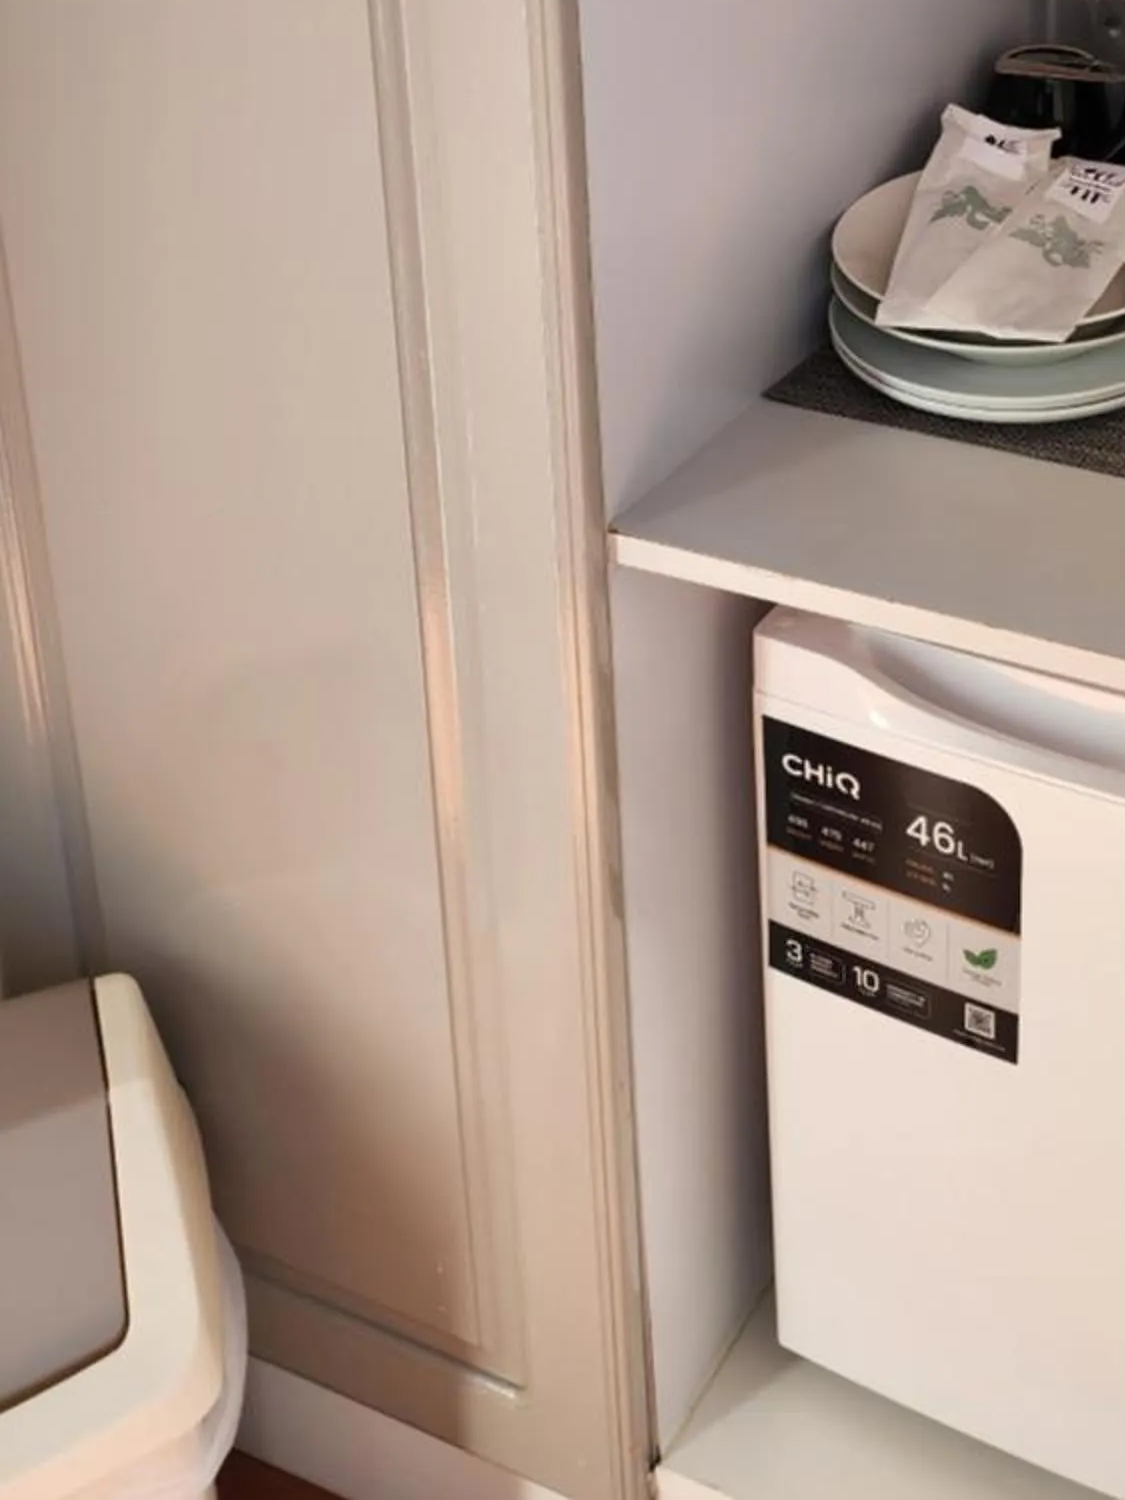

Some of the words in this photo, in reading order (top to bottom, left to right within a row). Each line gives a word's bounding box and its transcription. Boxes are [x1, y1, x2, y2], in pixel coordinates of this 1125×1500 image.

[782, 753, 860, 800] CHiQ
[785, 939, 804, 963] 3
[853, 965, 881, 994] 10
